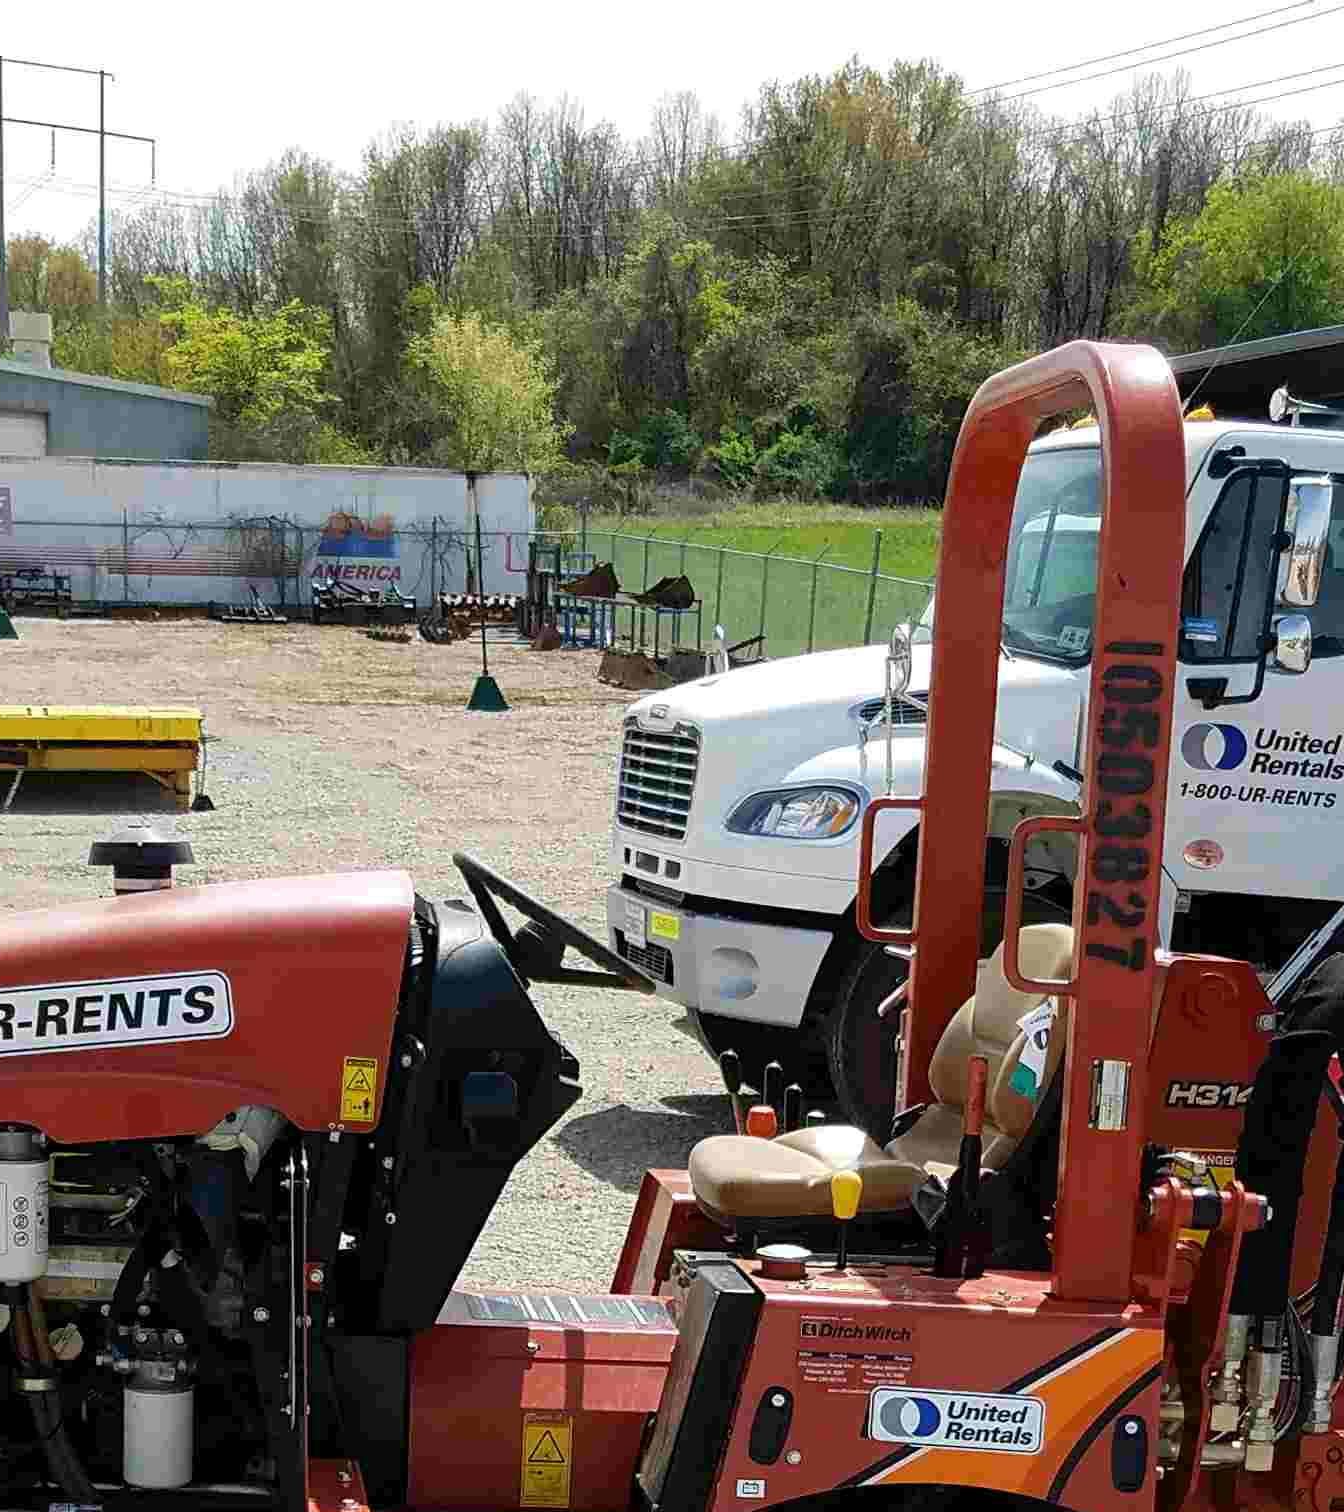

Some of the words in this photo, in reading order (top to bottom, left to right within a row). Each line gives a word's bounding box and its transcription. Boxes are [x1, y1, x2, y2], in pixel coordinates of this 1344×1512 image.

[1254, 728, 1343, 755] United
[1180, 782, 1337, 809] 1-800-UR-RENTS
[946, 1400, 1029, 1425] United
[944, 1422, 1033, 1446] Rentals
